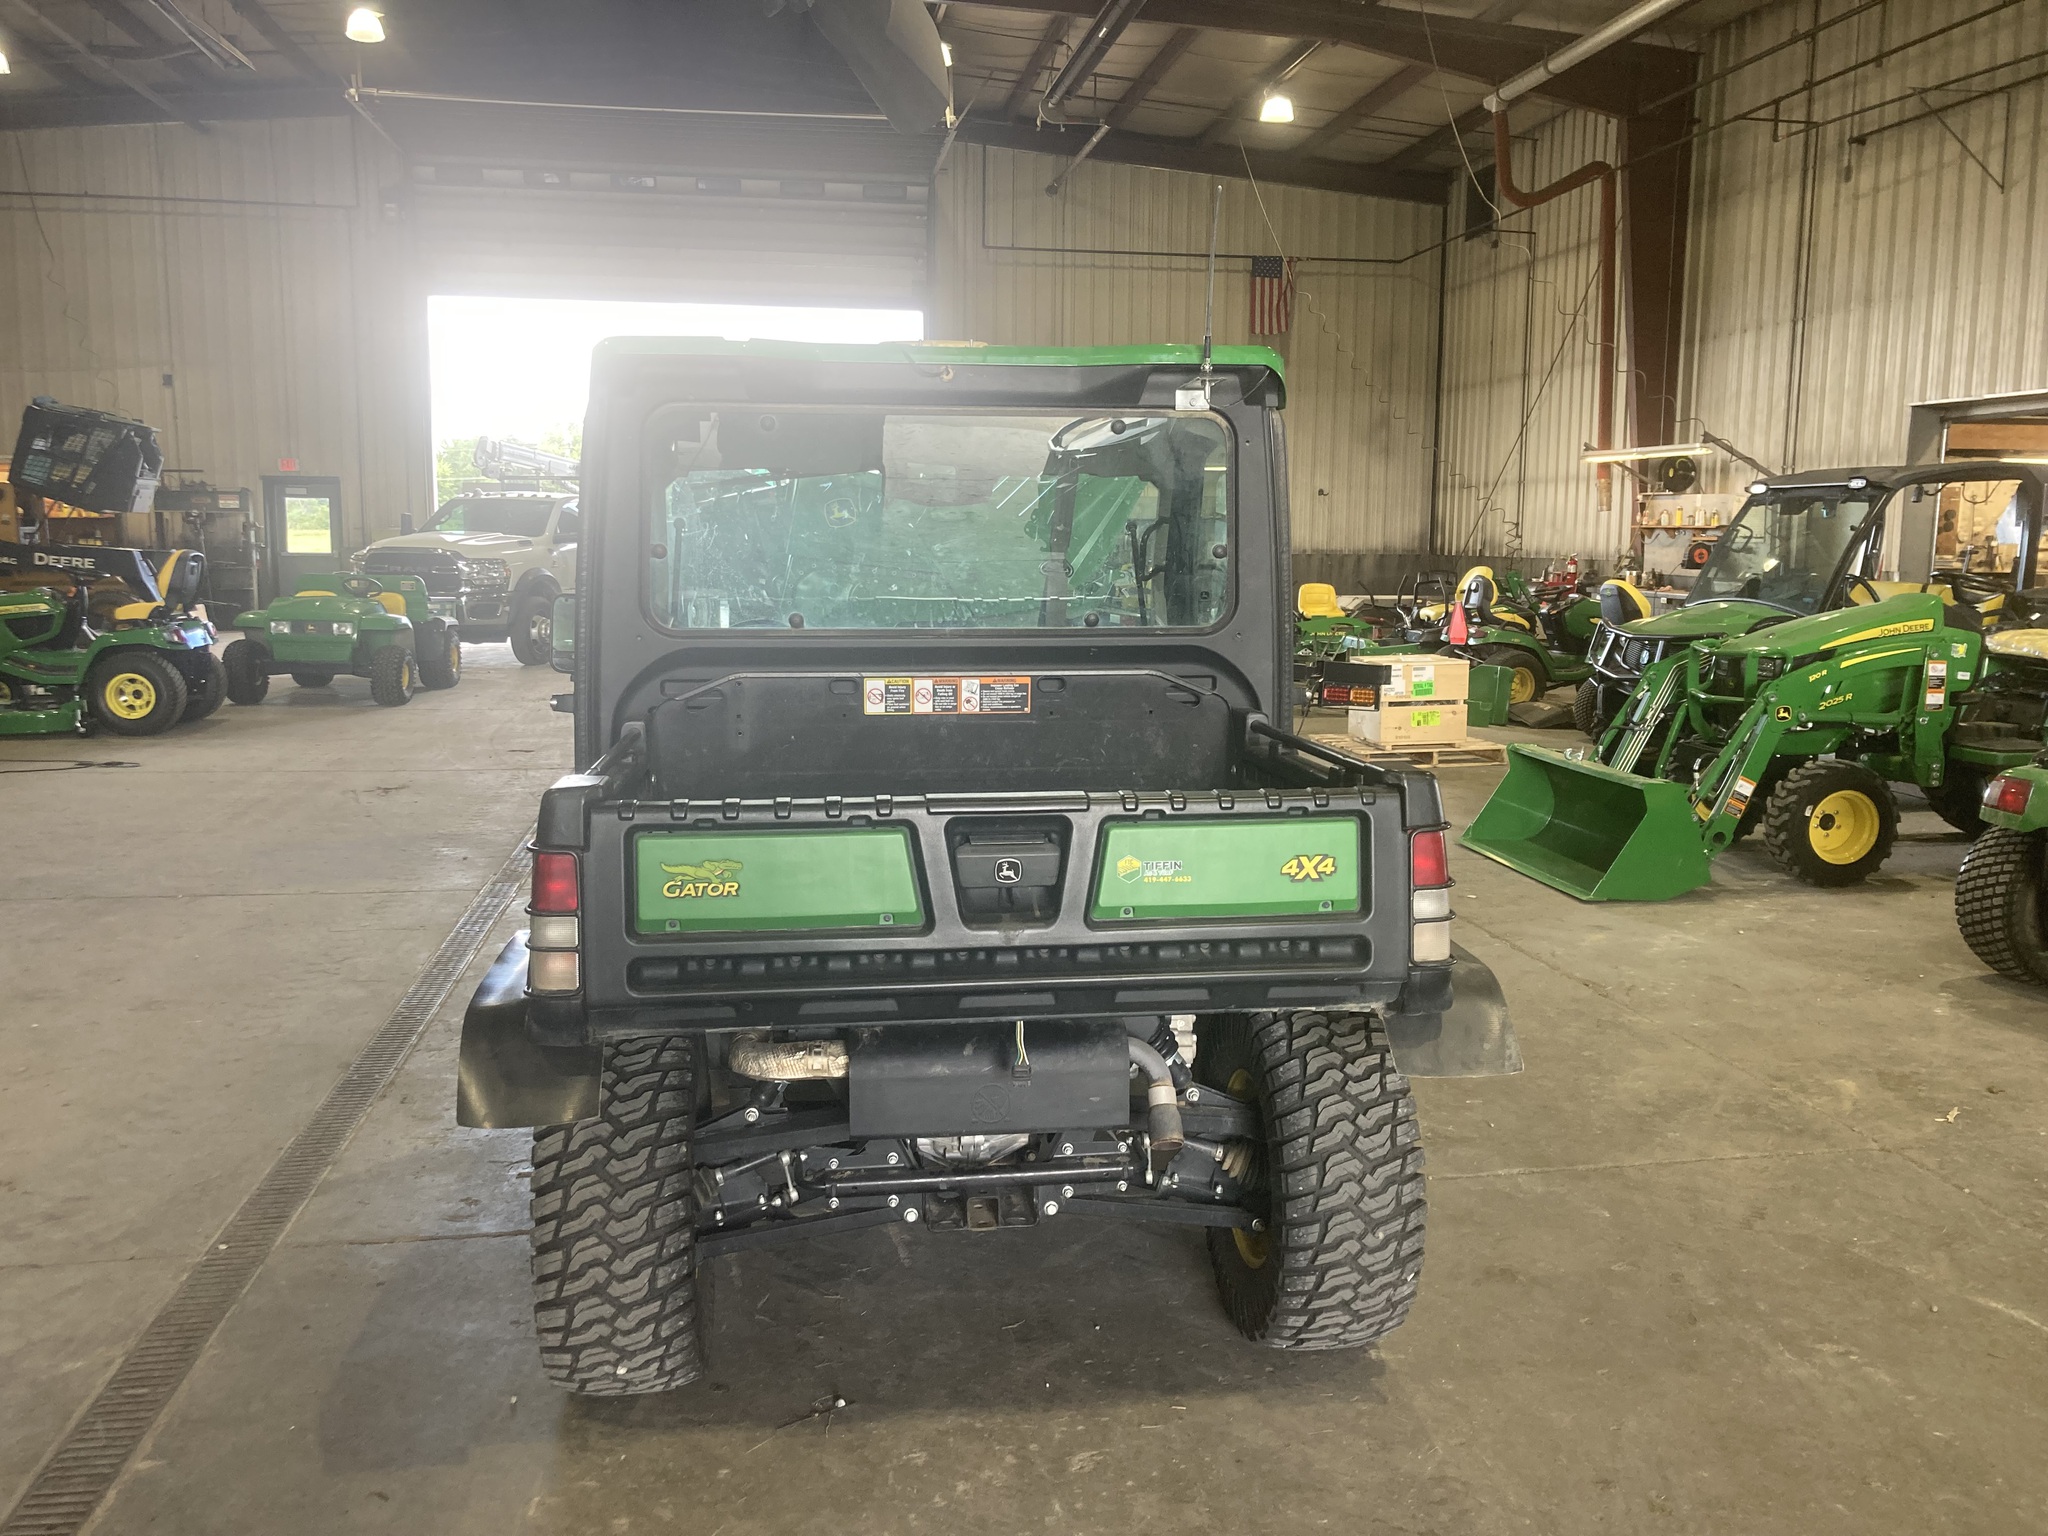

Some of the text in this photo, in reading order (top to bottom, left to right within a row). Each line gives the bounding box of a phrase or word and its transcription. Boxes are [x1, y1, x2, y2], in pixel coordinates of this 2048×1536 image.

[33, 552, 96, 569] DEERE
[1879, 623, 1930, 637] JOHN DEERE
[1818, 695, 1845, 711] 2025
[1143, 861, 1183, 870] TIFFIN
[1281, 855, 1337, 881] 4X4
[662, 880, 740, 898] GATOR
